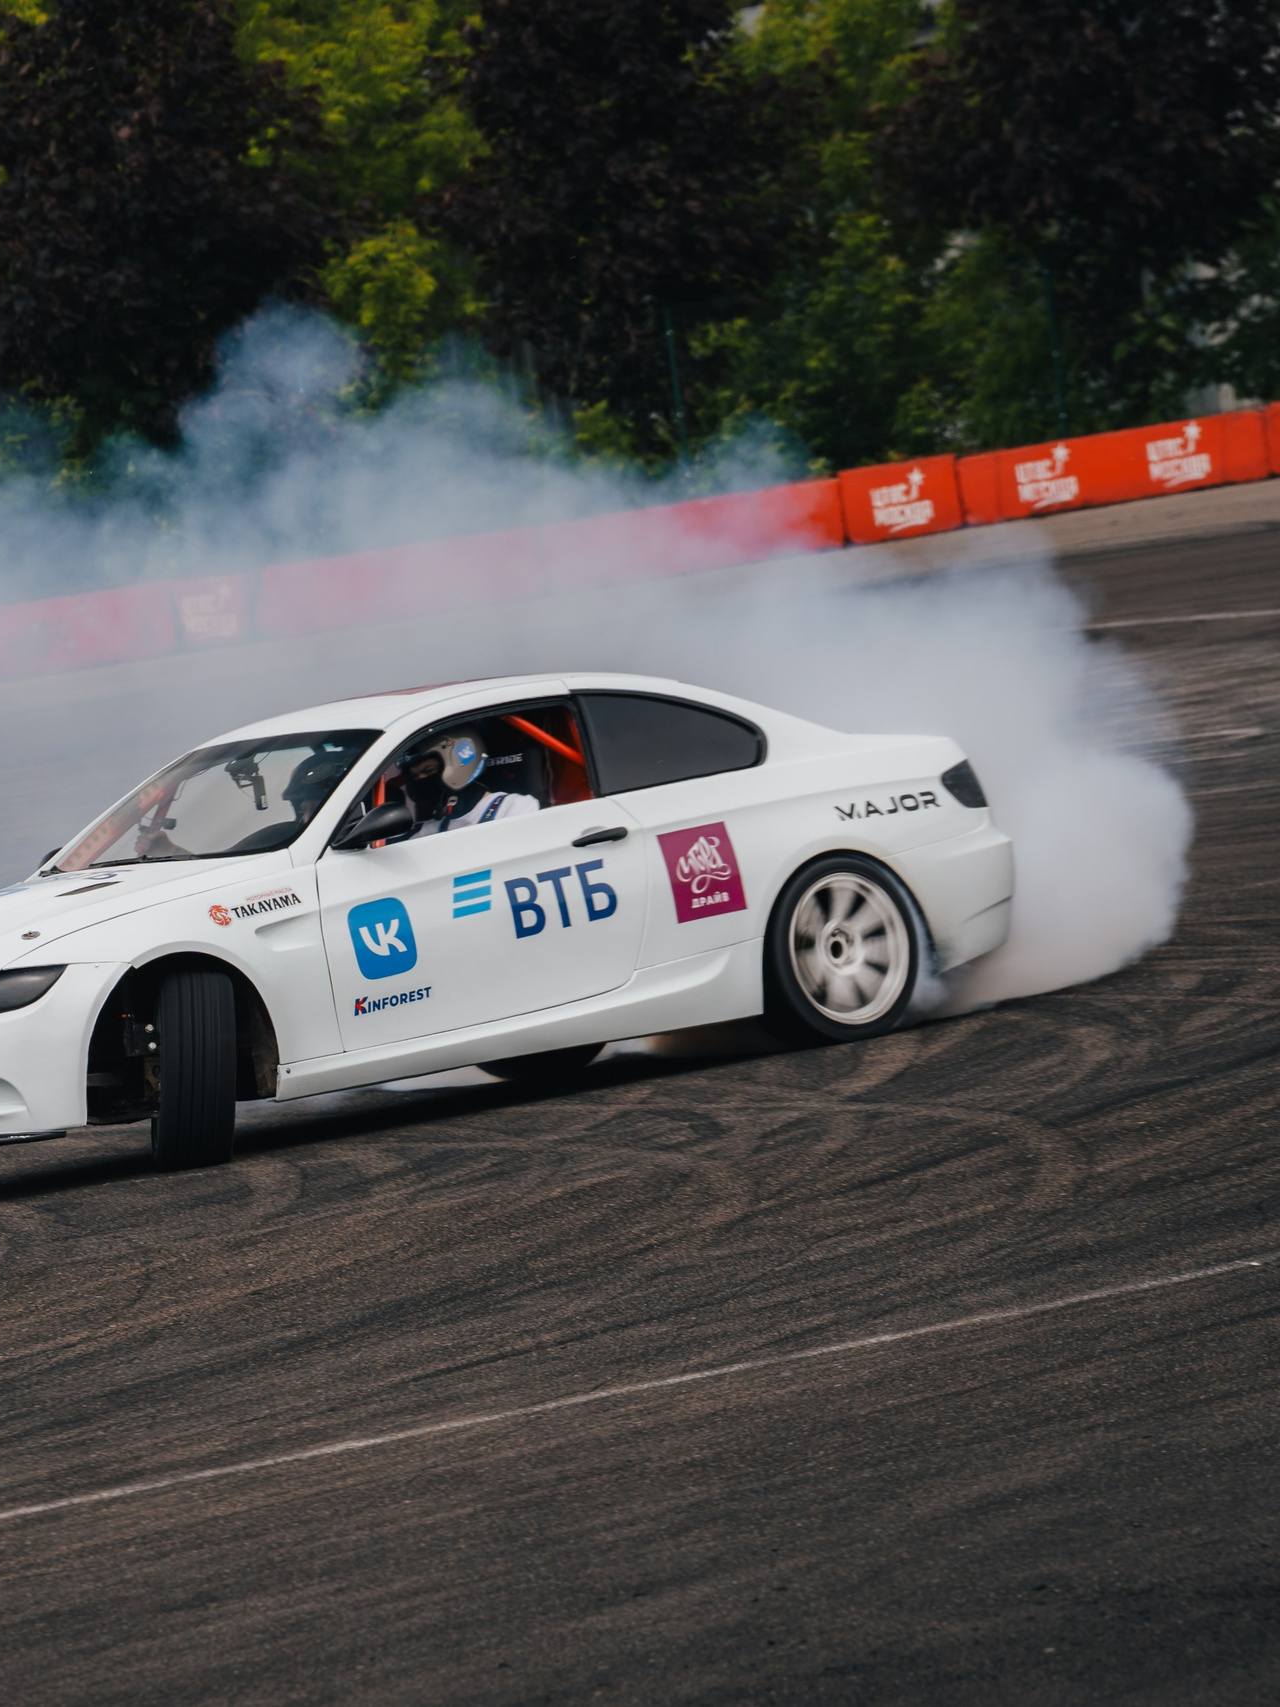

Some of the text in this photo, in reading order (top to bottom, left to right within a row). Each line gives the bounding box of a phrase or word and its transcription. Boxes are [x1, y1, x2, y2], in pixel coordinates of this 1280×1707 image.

[834, 791, 942, 821] MAJOR
[231, 893, 301, 918] TAKAYAMA
[504, 858, 617, 939] ВТБ
[691, 891, 730, 908] ДРАЙВ
[358, 918, 408, 956] VK
[354, 986, 432, 1016] KINFOREST
